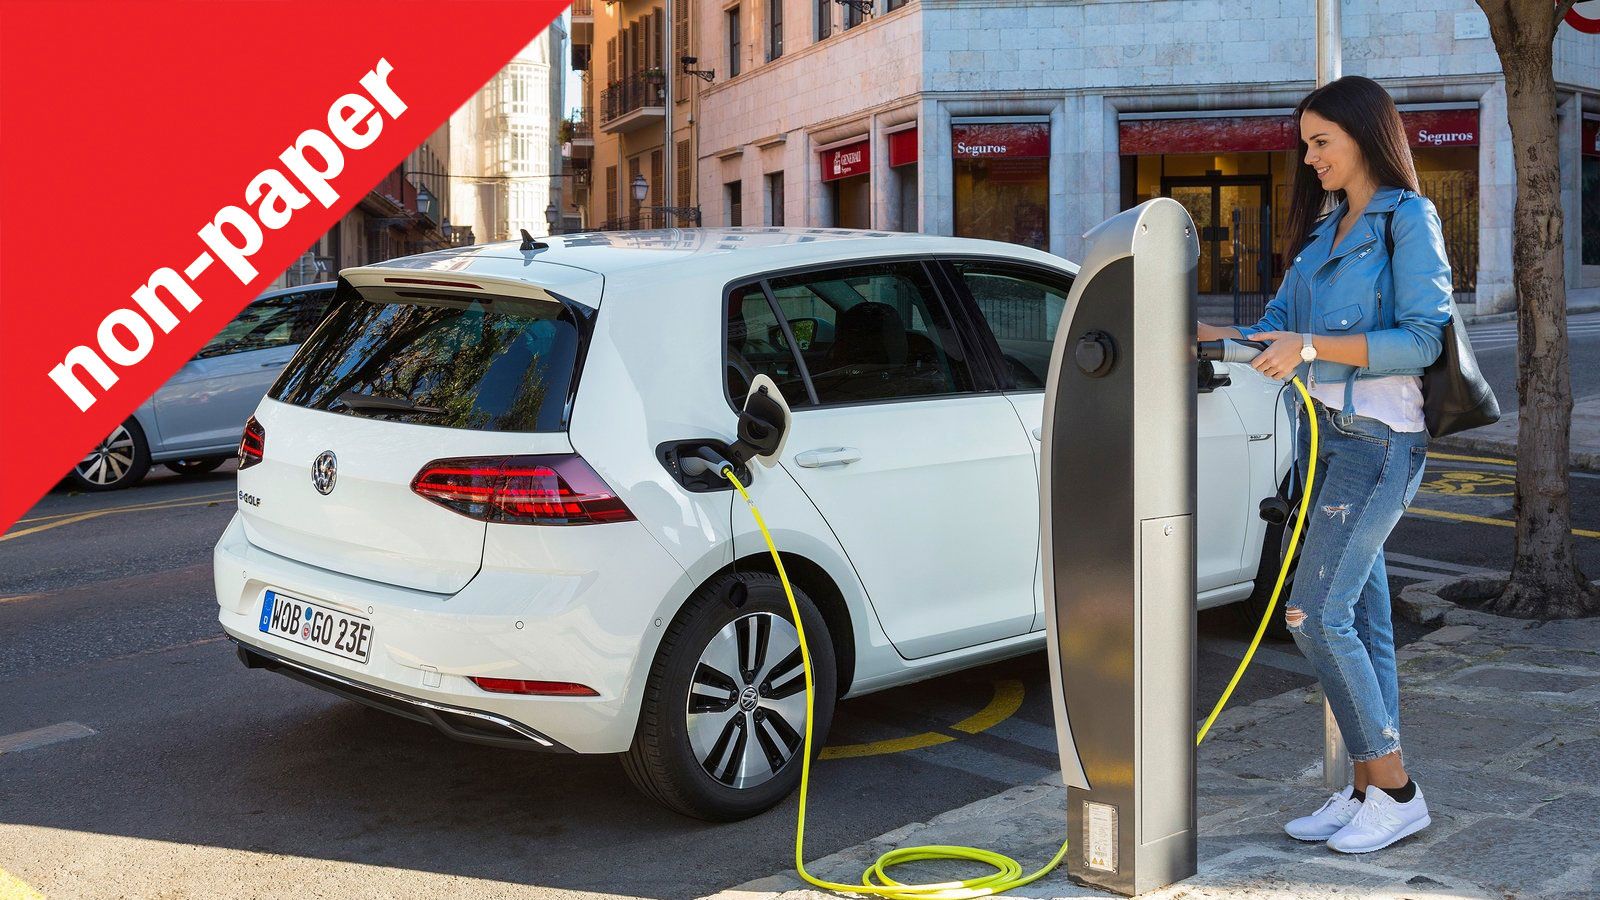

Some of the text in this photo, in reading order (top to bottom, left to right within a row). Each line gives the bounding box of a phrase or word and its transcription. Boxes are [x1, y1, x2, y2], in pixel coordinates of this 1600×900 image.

[1418, 130, 1473, 145] Seguros
[957, 142, 1007, 157] Seguros
[271, 598, 371, 657] WOB GO 23E
